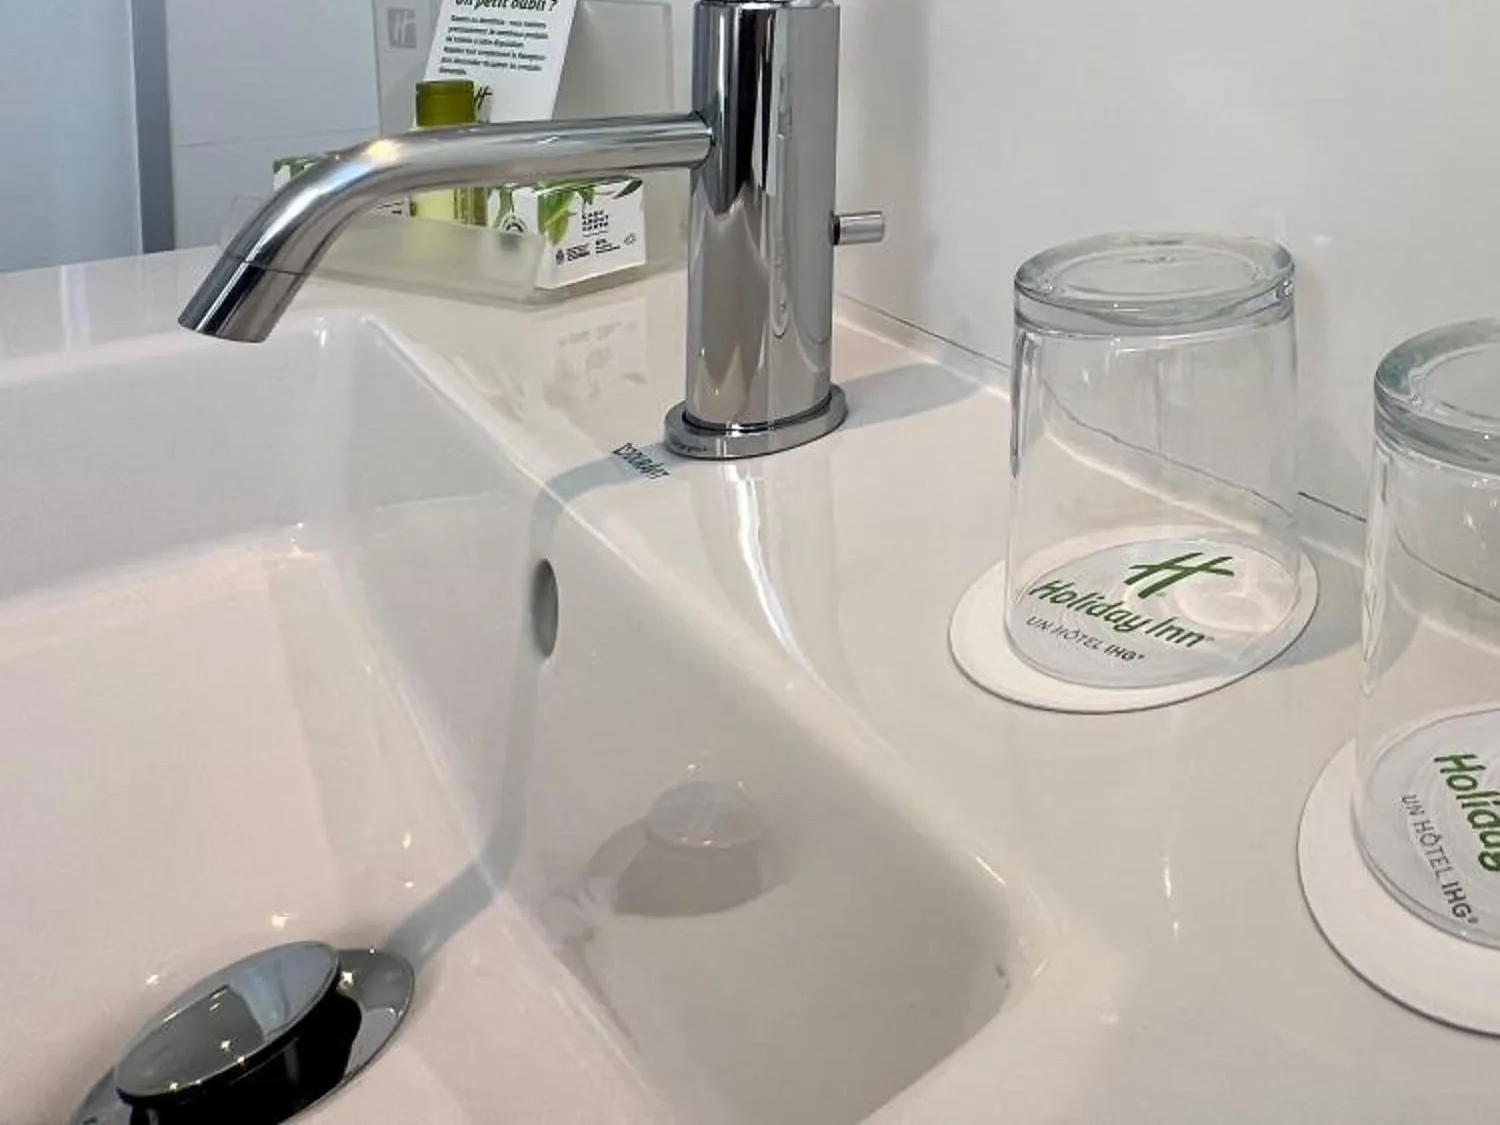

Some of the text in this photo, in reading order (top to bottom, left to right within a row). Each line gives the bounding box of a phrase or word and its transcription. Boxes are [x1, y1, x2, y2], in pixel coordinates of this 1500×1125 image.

[1025, 616, 1052, 632] UN
[1051, 624, 1105, 650] HÔTEL
[1028, 579, 1205, 648] Holiday Inn
[1401, 794, 1425, 816] UN
[1413, 820, 1453, 876] HÔTEL
